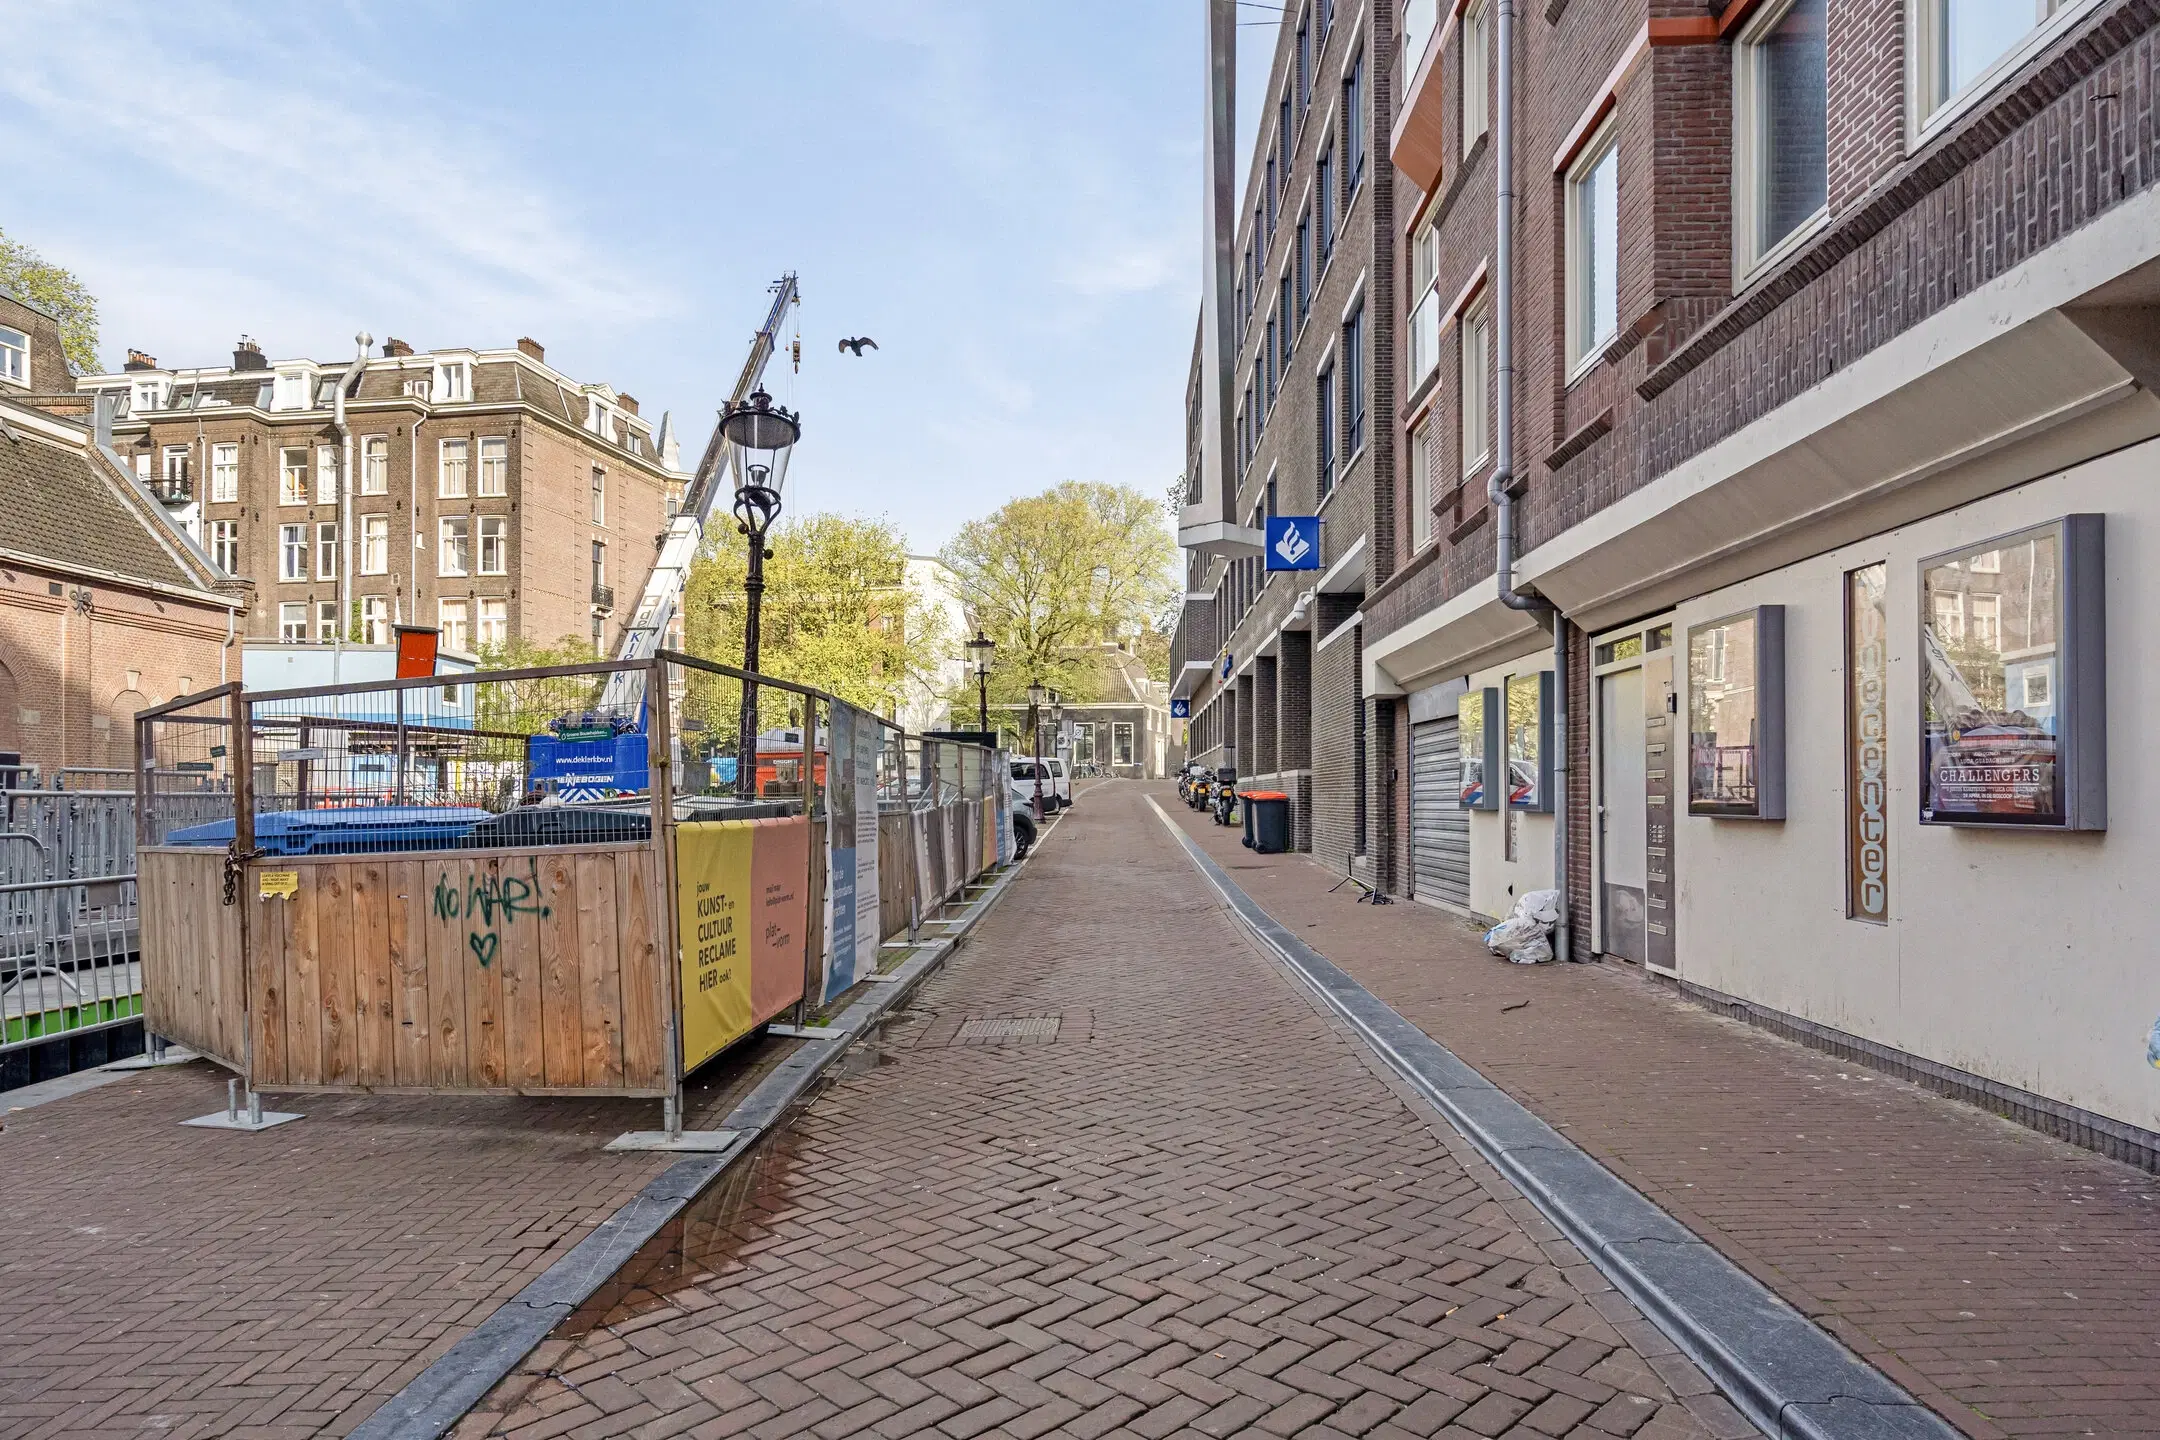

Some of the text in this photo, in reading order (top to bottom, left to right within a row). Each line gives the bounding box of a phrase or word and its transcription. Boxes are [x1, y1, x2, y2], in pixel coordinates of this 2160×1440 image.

[613, 609, 652, 684] de Klek
[556, 755, 613, 764] www.deklerkbv.nl
[1940, 768, 2040, 782] CHALLENGERS
[433, 872, 460, 922] NO
[696, 880, 710, 896] jouw
[697, 894, 735, 918] KUNST- en
[698, 916, 733, 943] CULTUUR
[698, 938, 736, 968] RECLAME
[699, 968, 732, 993] HIER ook?
